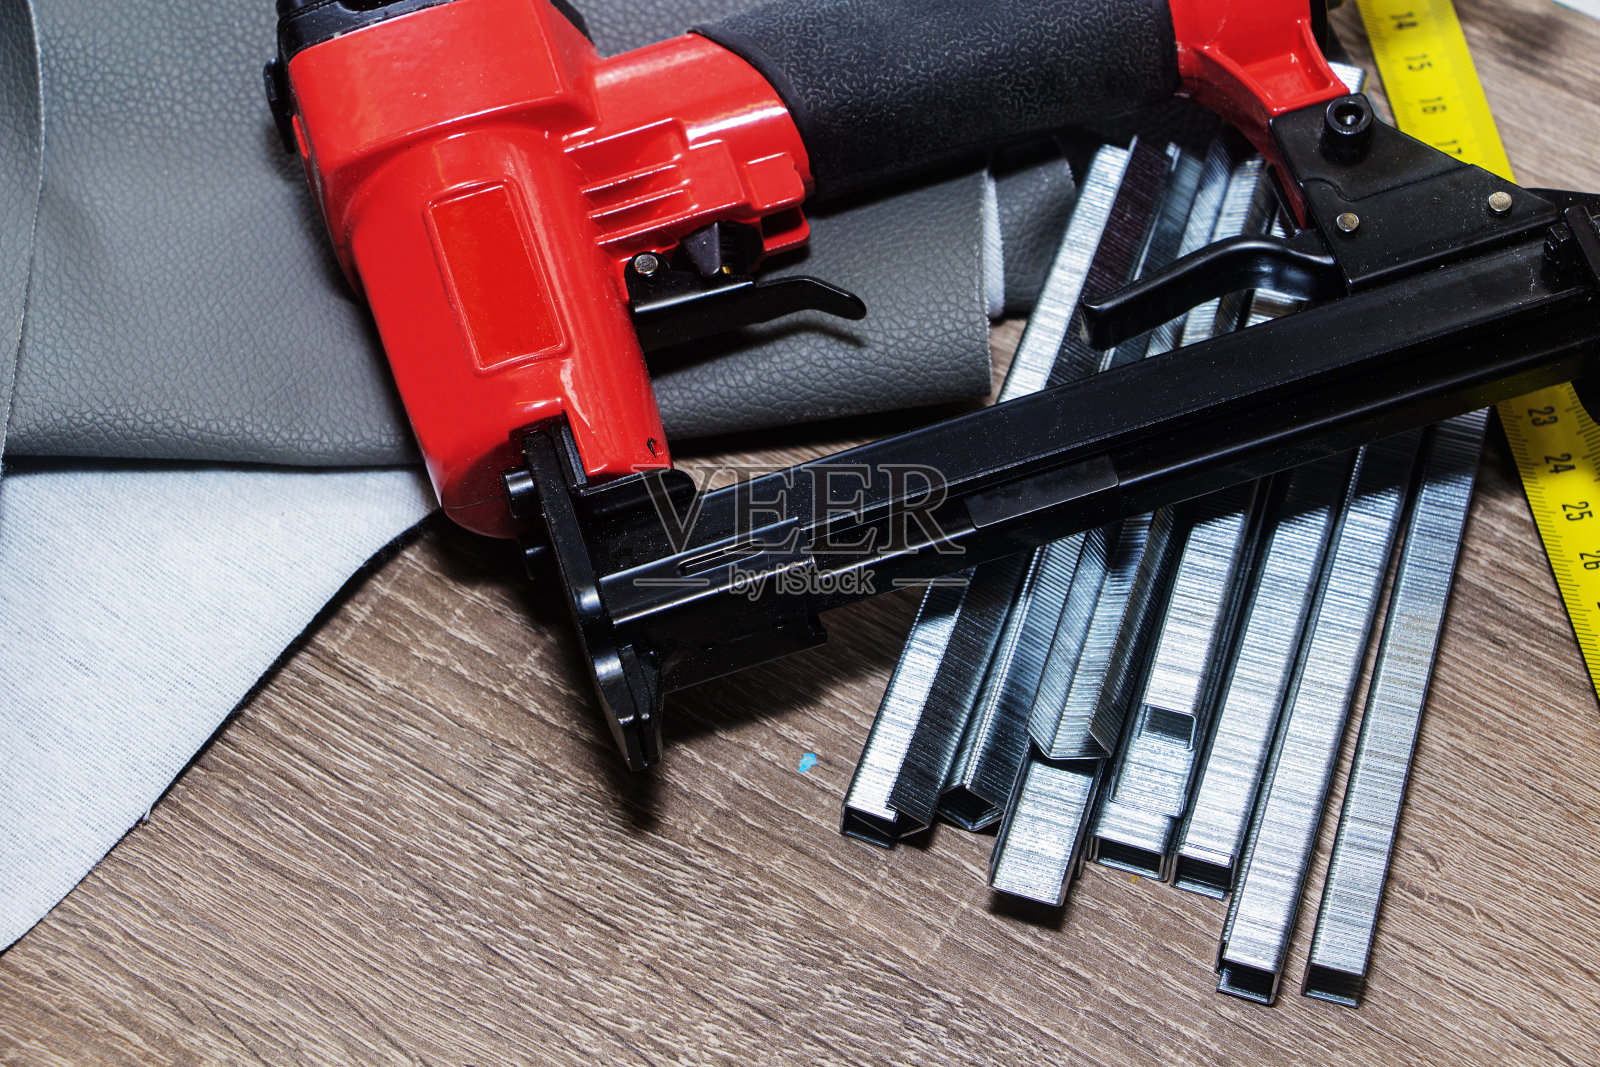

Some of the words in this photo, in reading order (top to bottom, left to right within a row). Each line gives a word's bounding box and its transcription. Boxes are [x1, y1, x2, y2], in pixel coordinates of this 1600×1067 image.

[1389, 11, 1419, 30] 14
[1404, 53, 1433, 71] 15
[1419, 96, 1447, 114] 16
[1434, 139, 1463, 155] 17
[1527, 405, 1559, 427] 23
[1543, 452, 1576, 475] 24
[1561, 500, 1594, 521] 25
